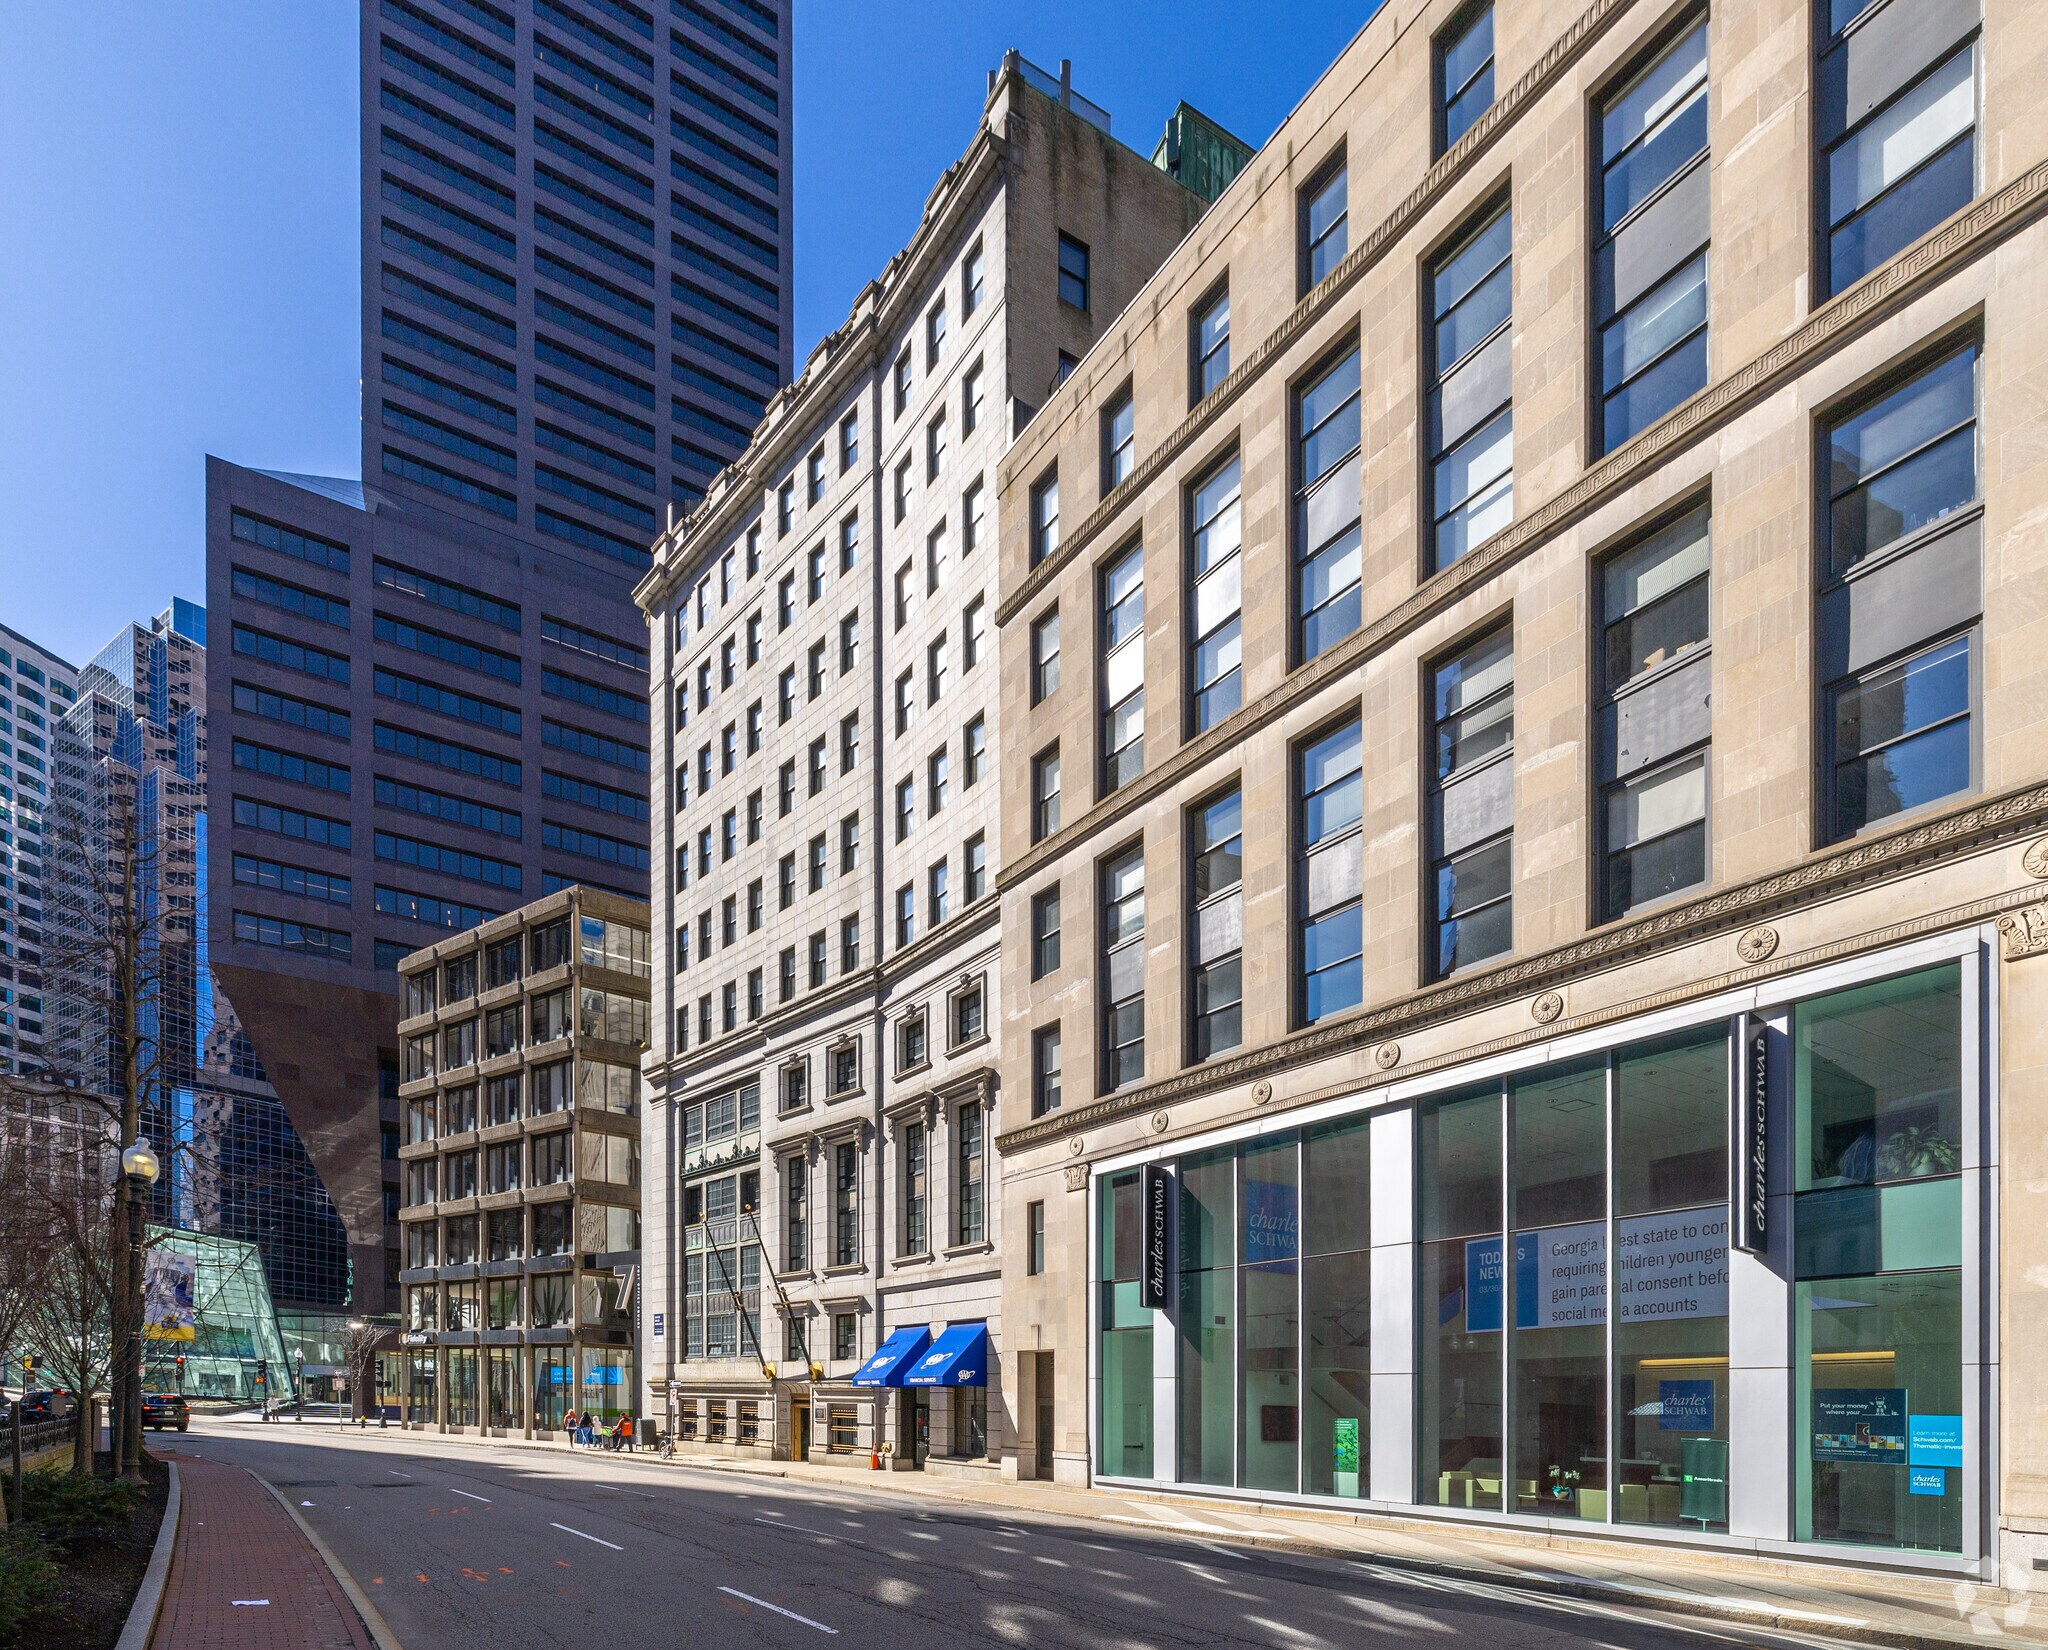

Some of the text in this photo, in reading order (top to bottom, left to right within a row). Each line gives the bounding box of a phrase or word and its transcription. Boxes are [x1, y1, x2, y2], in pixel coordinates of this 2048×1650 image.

[1753, 1038, 1766, 1232] charles SCHWAB
[1250, 1208, 1298, 1232] charle
[1150, 1179, 1164, 1297] charles SCHWAB
[1250, 1231, 1297, 1249] SCHWA
[1551, 1237, 1599, 1257] Georgia
[1602, 1232, 1639, 1250] lest
[1643, 1226, 1678, 1244] state
[1682, 1225, 1697, 1239] to
[1478, 1247, 1526, 1266] TODS
[1551, 1260, 1607, 1280] requiring
[1668, 1246, 1729, 1269] younger
[1479, 1265, 1503, 1281] NEW
[613, 1264, 635, 1309] 7
[1551, 1285, 1577, 1304] gain
[1580, 1278, 1633, 1301] pareal
[1637, 1273, 1694, 1292] consent
[1551, 1298, 1698, 1322] social mea accounts
[407, 1334, 427, 1344] Fidelity
[1664, 1393, 1706, 1406] charles
[1664, 1406, 1707, 1415] SCHWAB
[1912, 1474, 1941, 1483] charles
